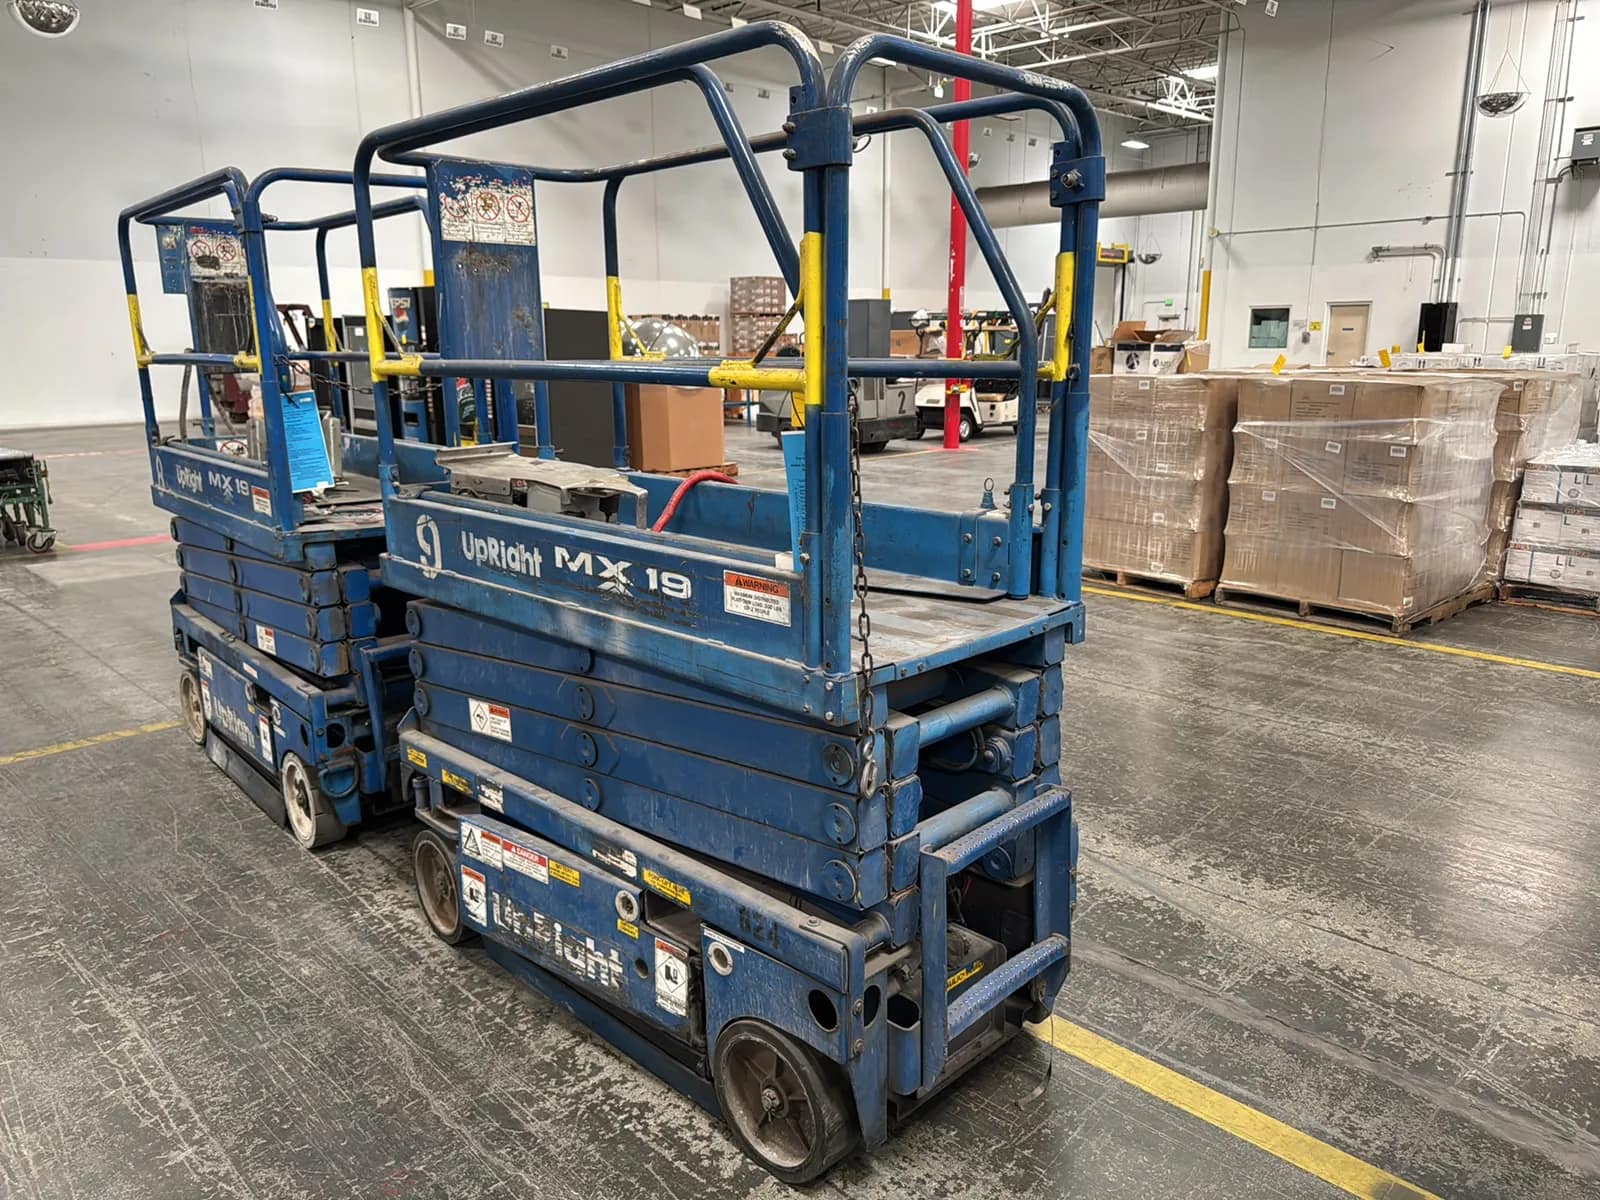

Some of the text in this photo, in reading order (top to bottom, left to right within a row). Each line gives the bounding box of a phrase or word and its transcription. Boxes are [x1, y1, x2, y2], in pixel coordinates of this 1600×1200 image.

[897, 390, 906, 415] 2
[208, 470, 233, 494] MX
[235, 478, 249, 496] 19
[416, 514, 442, 580] 9
[461, 530, 692, 600] UpRight MX 19
[742, 579, 779, 594] WARNING
